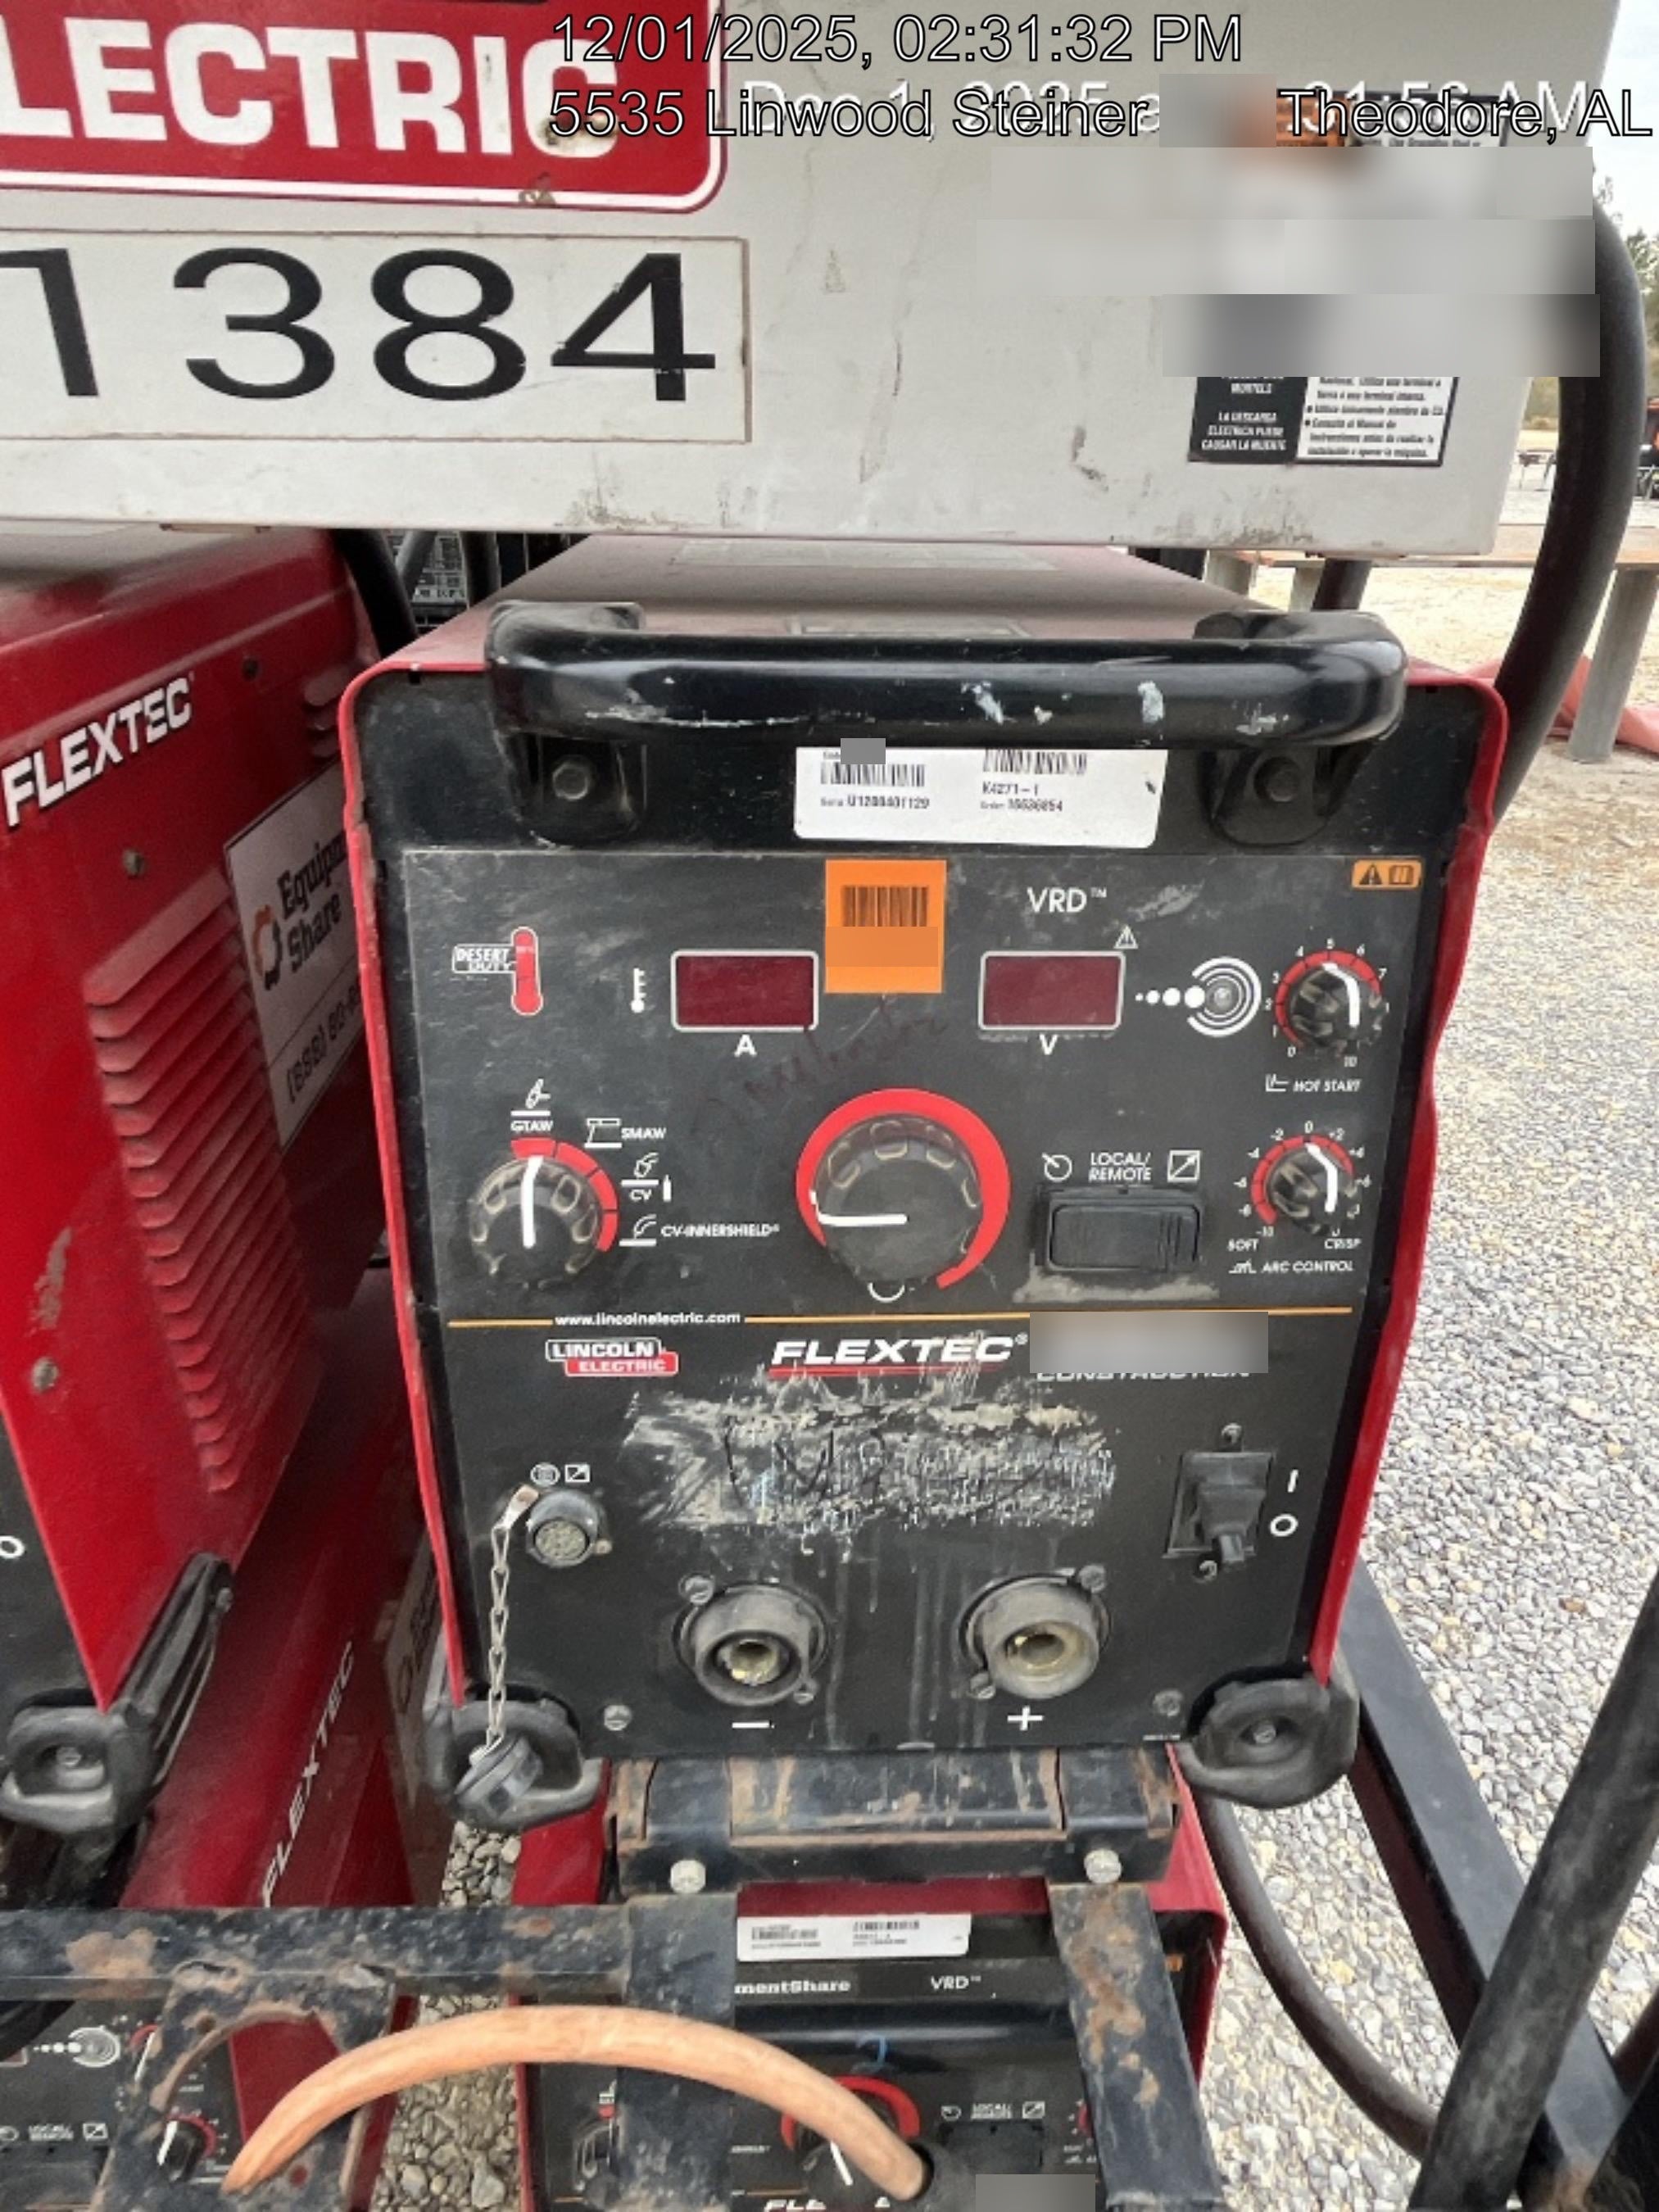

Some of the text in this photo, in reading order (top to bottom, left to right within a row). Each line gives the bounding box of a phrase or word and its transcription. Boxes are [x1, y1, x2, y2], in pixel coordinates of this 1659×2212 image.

[288, 893, 342, 973] Share
[456, 948, 510, 962] DESERT
[734, 1034, 1058, 1057] A V
[1089, 1167, 1152, 1181] REMOTE
[629, 1188, 652, 1202] CV
[555, 1312, 741, 1327] www.lincolnelectric.com
[551, 1340, 655, 1358] LINCOLN
[578, 1358, 668, 1373] ELECTRIC
